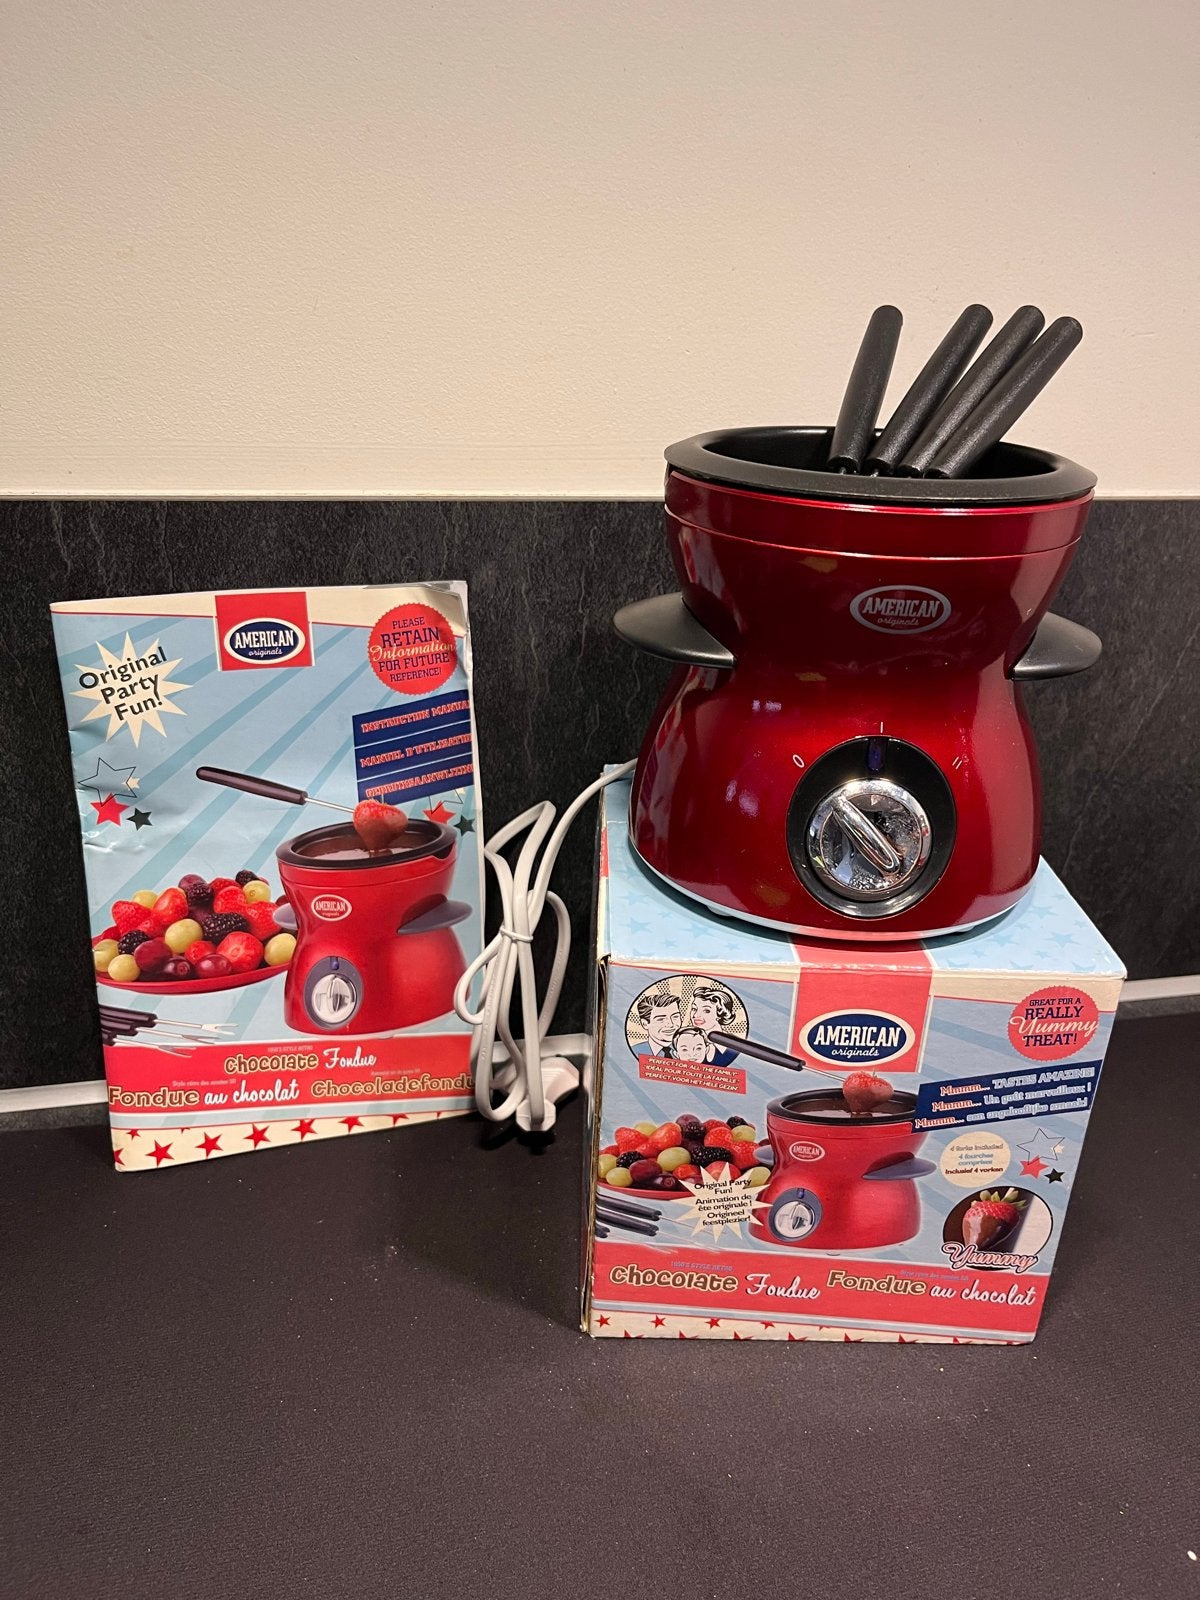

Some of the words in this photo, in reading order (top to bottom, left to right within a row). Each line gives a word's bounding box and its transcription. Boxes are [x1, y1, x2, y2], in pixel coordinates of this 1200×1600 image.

[862, 597, 940, 617] AMERICAN
[392, 617, 426, 630] PLEASE
[877, 616, 919, 627] originals
[234, 630, 295, 650] AMERICAN
[380, 626, 441, 649] RETAIN
[248, 647, 283, 658] originals
[369, 640, 454, 662] Information
[79, 645, 168, 690] Original
[378, 659, 402, 673] FOR
[404, 651, 450, 670] FUTURE
[389, 667, 442, 683] REFERENCE!
[100, 673, 161, 705] Party
[114, 696, 164, 721] Fun!
[431, 700, 471, 717] MANUA
[315, 900, 346, 911] AMERICAN
[1029, 999, 1057, 1007] GREAT
[1024, 1006, 1085, 1020] REALLY
[1009, 1016, 1097, 1039] Yummy
[813, 1025, 902, 1047] AMERICAN
[1023, 1033, 1078, 1047] TREAT!
[322, 1045, 377, 1070] Fondue
[831, 1046, 880, 1059] originals
[664, 1067, 682, 1075] POUR
[675, 1061, 688, 1069] FOR
[672, 1076, 690, 1084] VOOR
[992, 1074, 1038, 1090] TASTES
[108, 1086, 200, 1107] Fondue
[204, 1092, 229, 1106] au
[232, 1078, 301, 1104] chocolat
[983, 1094, 1000, 1106] Un
[966, 1113, 986, 1122] een
[694, 1180, 728, 1190] Original
[729, 1179, 752, 1190] Party
[695, 1195, 740, 1205] Animation
[713, 1201, 748, 1210] originale
[707, 1209, 745, 1219] Origineel
[941, 1241, 1039, 1274] Yummy
[745, 1273, 821, 1300] Fondue
[826, 1269, 928, 1296] Fondue
[929, 1284, 957, 1298] au
[961, 1278, 1037, 1306] chocolat
